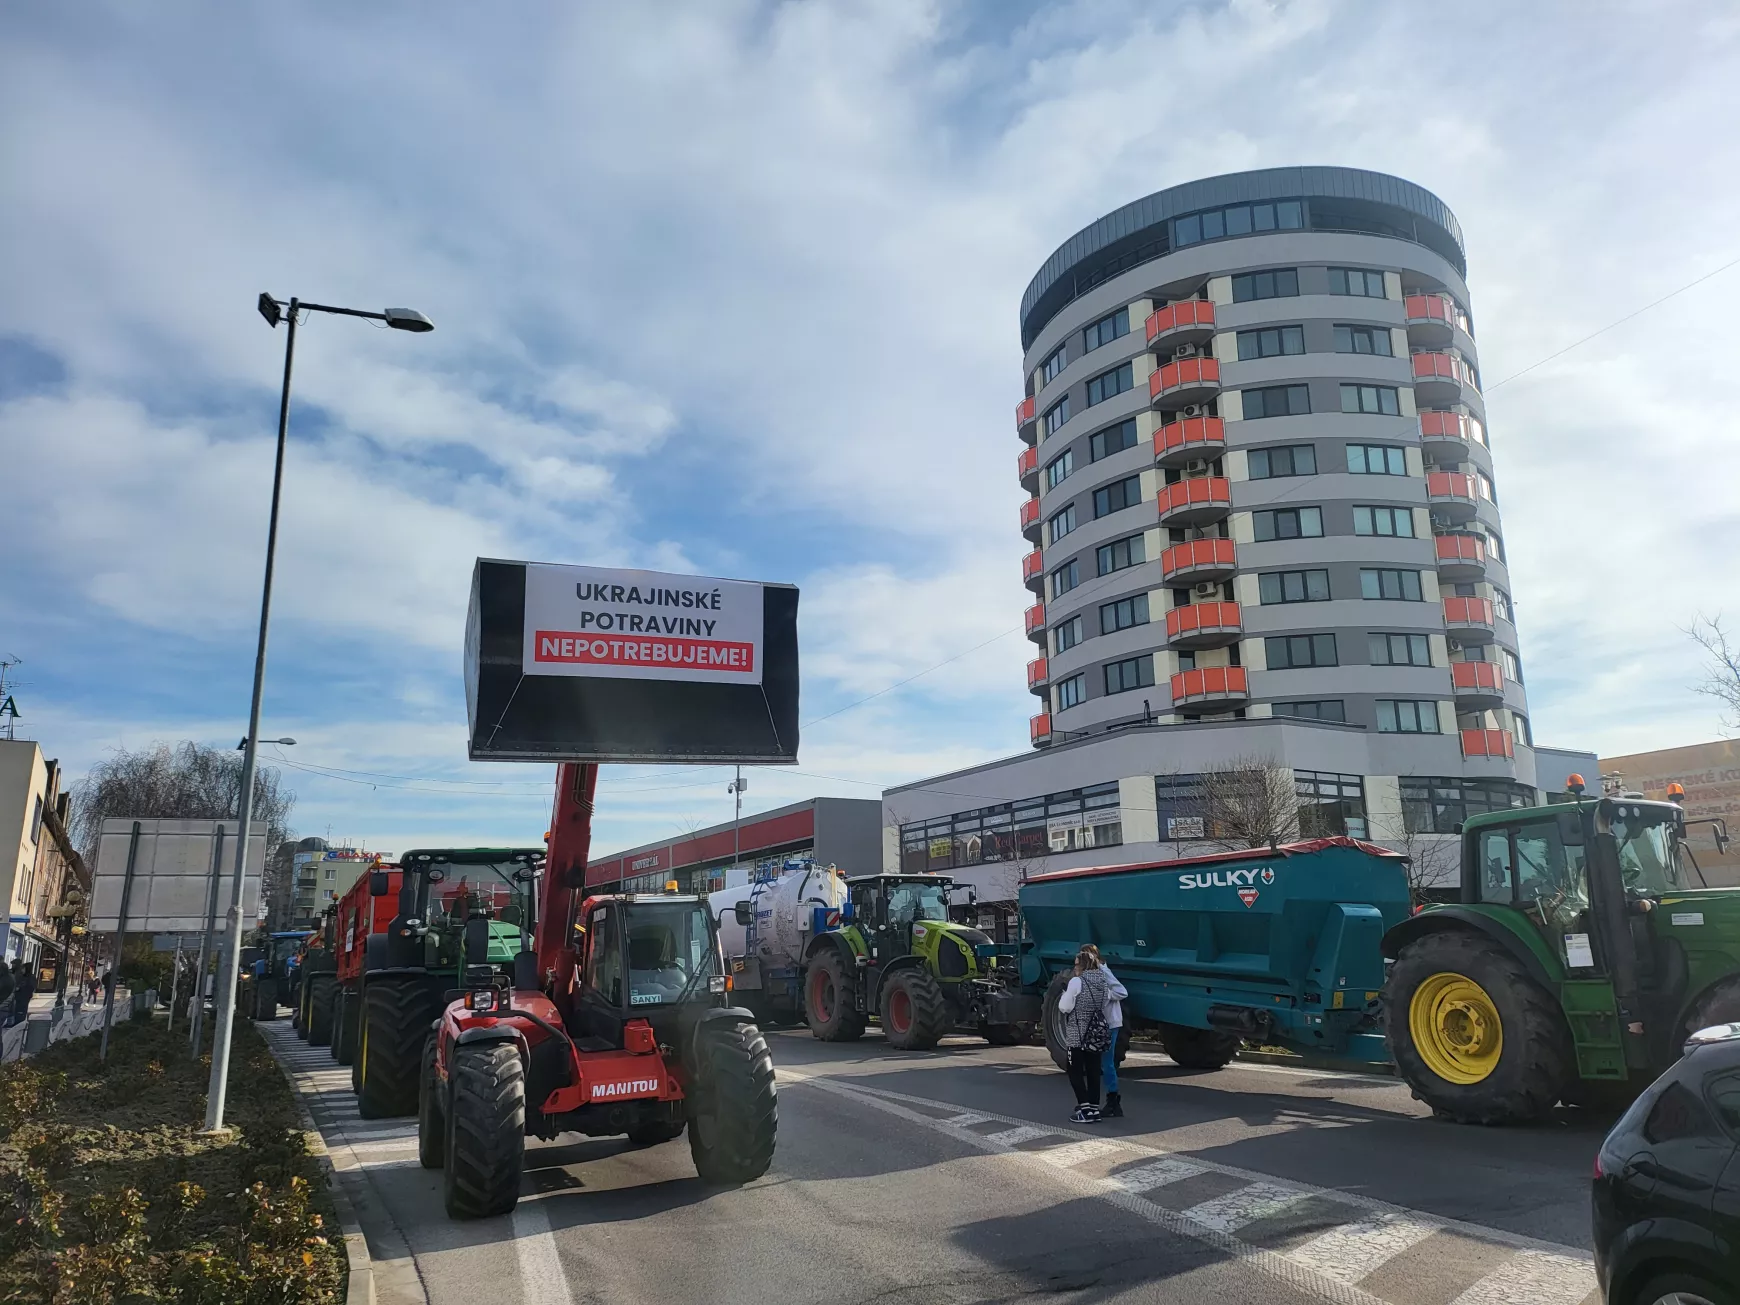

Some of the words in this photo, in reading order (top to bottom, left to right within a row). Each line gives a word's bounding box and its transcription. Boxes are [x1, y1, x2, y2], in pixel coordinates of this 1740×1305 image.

[576, 582, 722, 610] UKRAJINSKÉ
[580, 611, 717, 637] POTRAVINY
[541, 637, 748, 667] NEPOTREBUJEME!
[1178, 868, 1260, 890] SULKY
[631, 995, 662, 1005] SANYI
[592, 1079, 658, 1097] MANITOU
